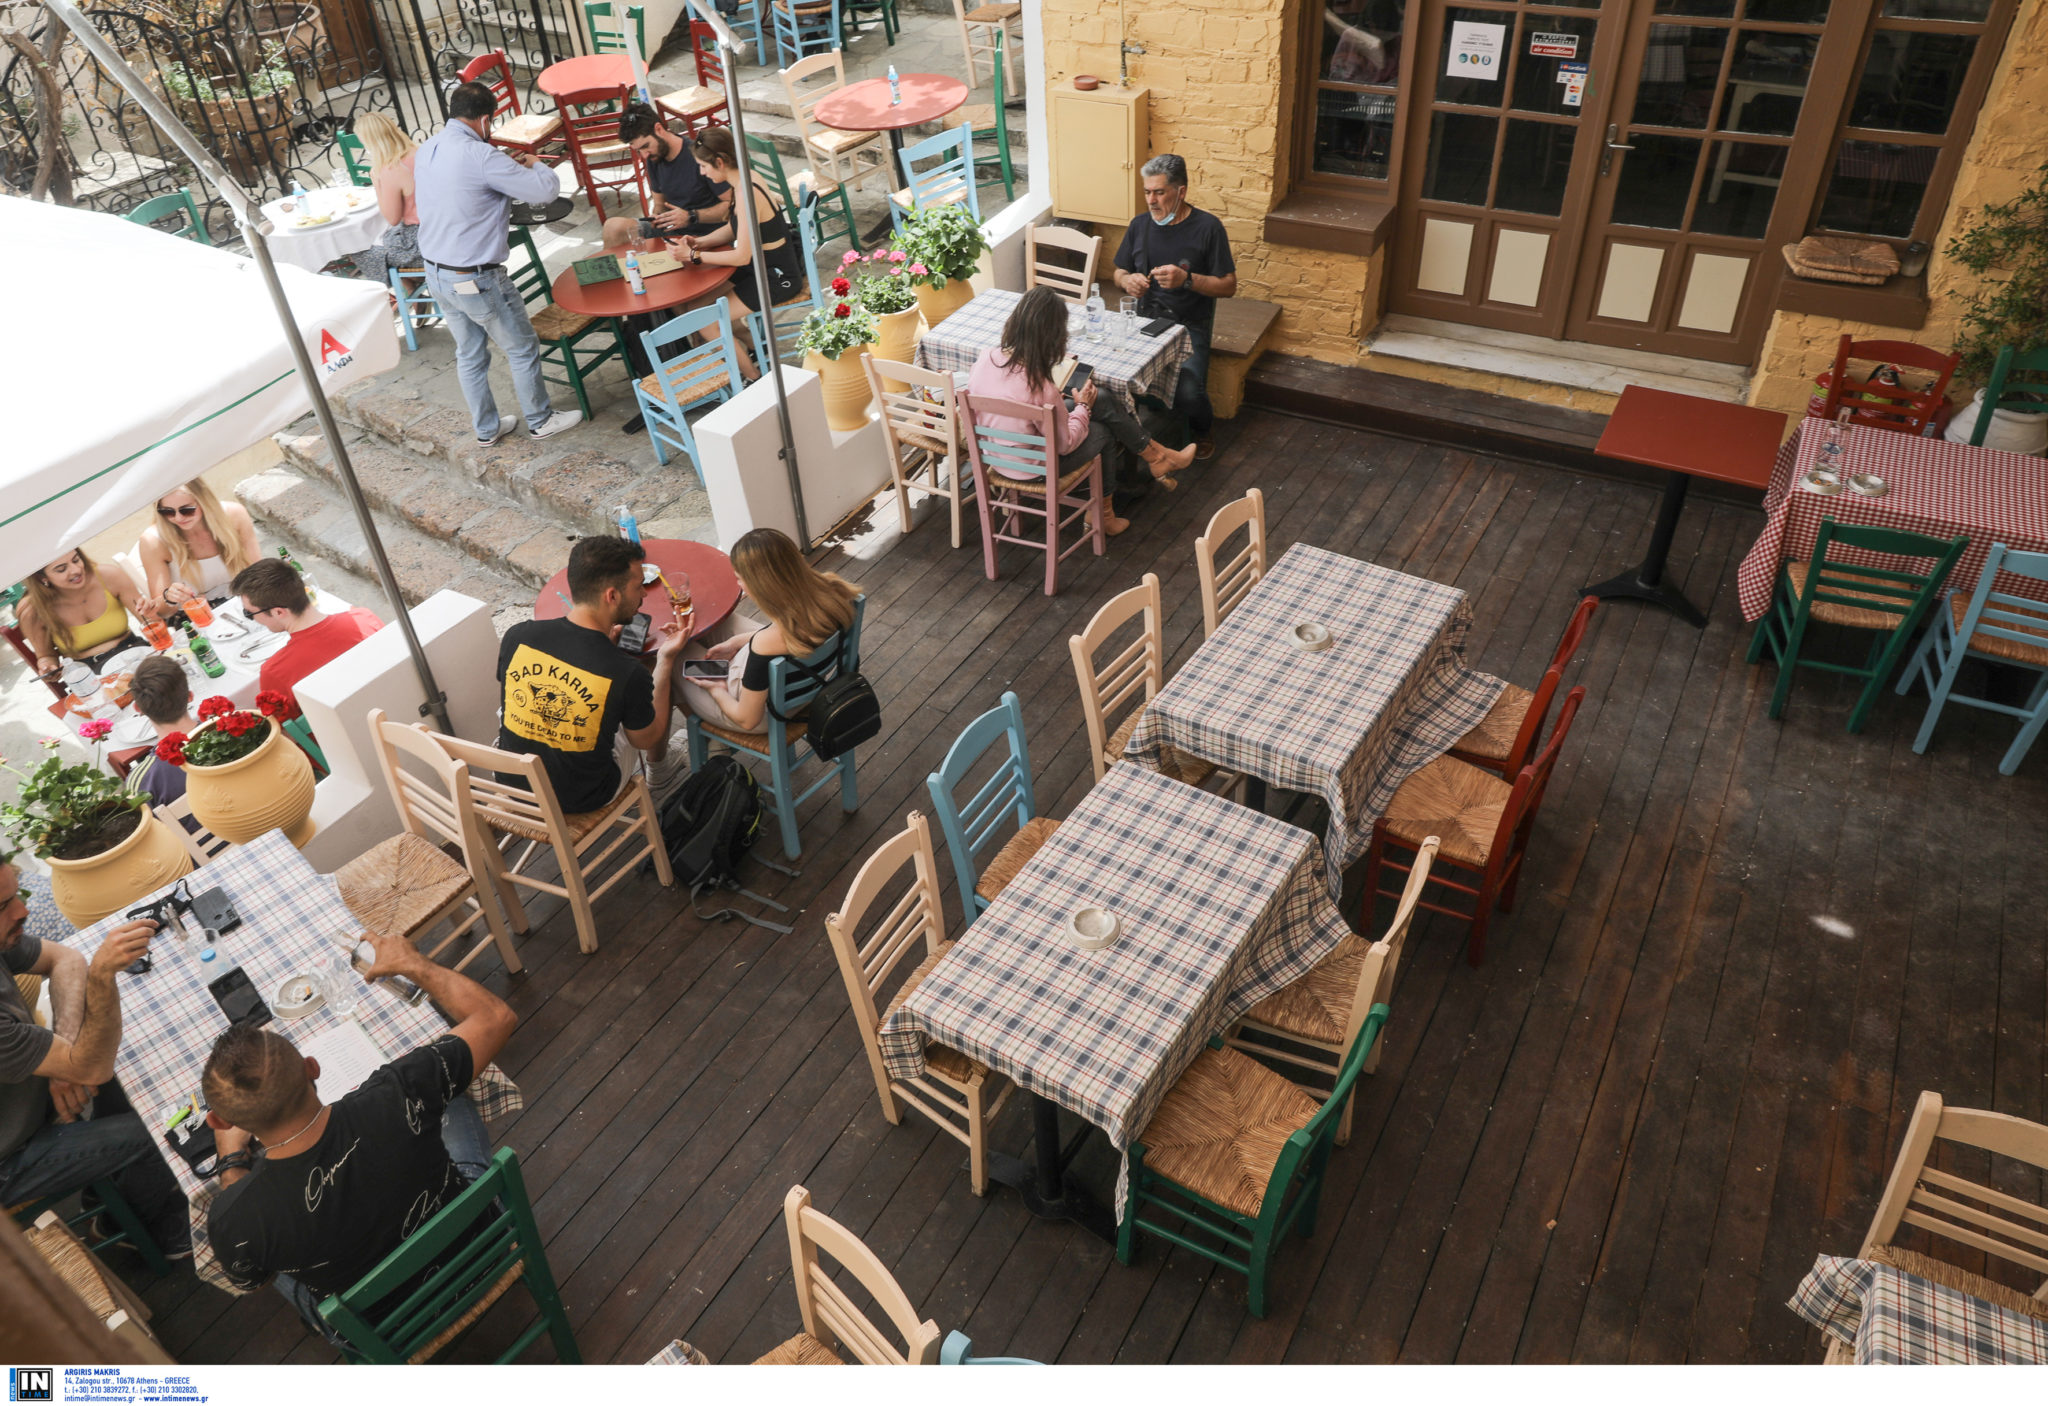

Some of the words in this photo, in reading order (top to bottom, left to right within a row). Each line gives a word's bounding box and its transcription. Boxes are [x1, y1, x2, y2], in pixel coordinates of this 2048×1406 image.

[510, 663, 543, 683] BAD
[548, 665, 600, 713] KARMA
[511, 713, 535, 730] YOU'RE
[560, 731, 571, 741] TO
[573, 735, 587, 743] ME
